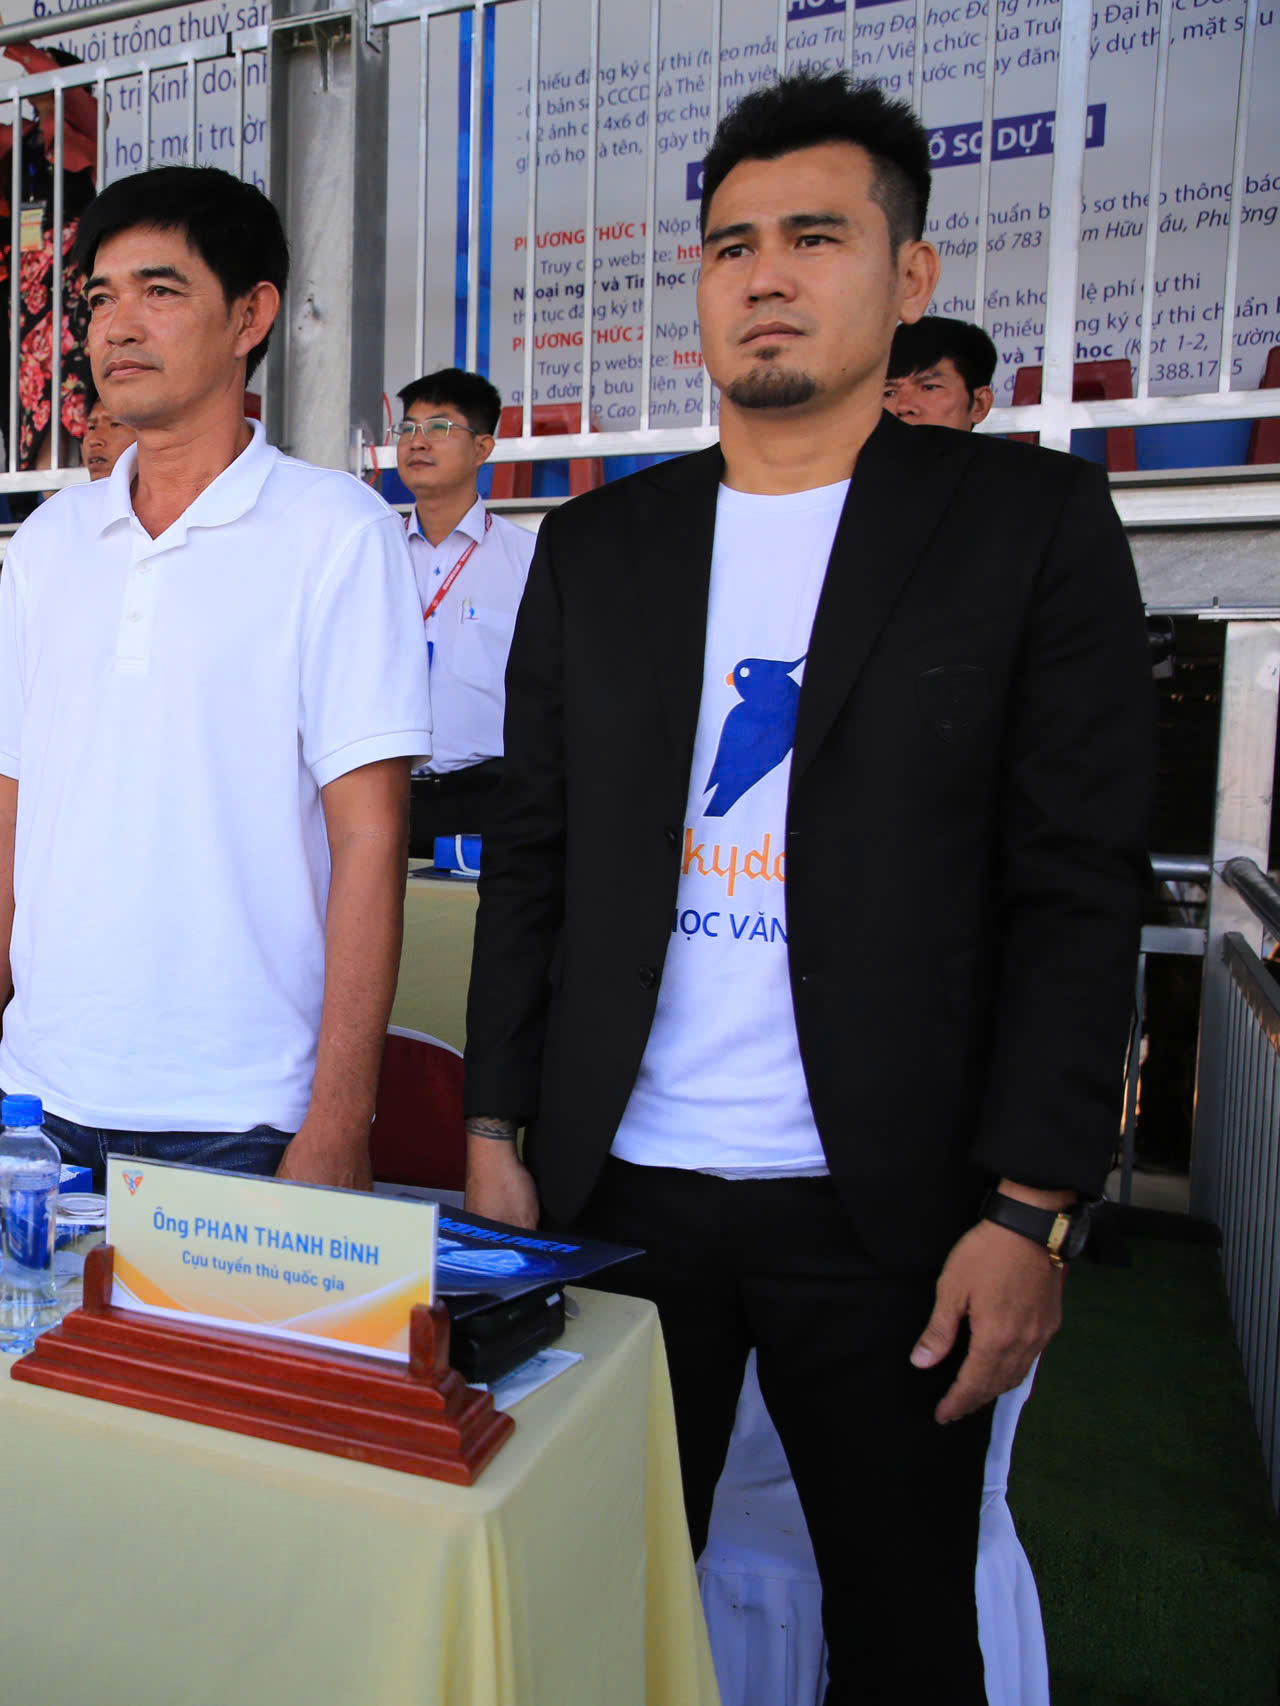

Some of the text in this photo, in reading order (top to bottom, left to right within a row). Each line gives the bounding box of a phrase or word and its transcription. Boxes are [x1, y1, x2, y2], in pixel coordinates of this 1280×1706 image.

[527, 67, 570, 94] hiếu
[697, 45, 739, 67] (teo
[890, 14, 917, 34] Đạ
[636, 109, 676, 128] đợc
[680, 102, 710, 122] chụ
[1018, 47, 1061, 69] đăn
[1234, 10, 1274, 32] su
[997, 118, 1042, 154] DỰ
[1011, 230, 1043, 250] 783
[1159, 212, 1188, 234] ầu,
[608, 248, 672, 268] webste:
[513, 281, 559, 303] Noại
[655, 271, 686, 288] học
[1174, 272, 1201, 292] thi
[1106, 310, 1129, 333] ký
[1169, 304, 1195, 324] thi
[512, 330, 584, 352] PƯƠNG
[605, 353, 670, 372] webste:
[152, 1206, 380, 1266] Ông PHAN THANH BÌNH
[181, 1249, 345, 1292] Cựu tuyển thủ quốc gia
